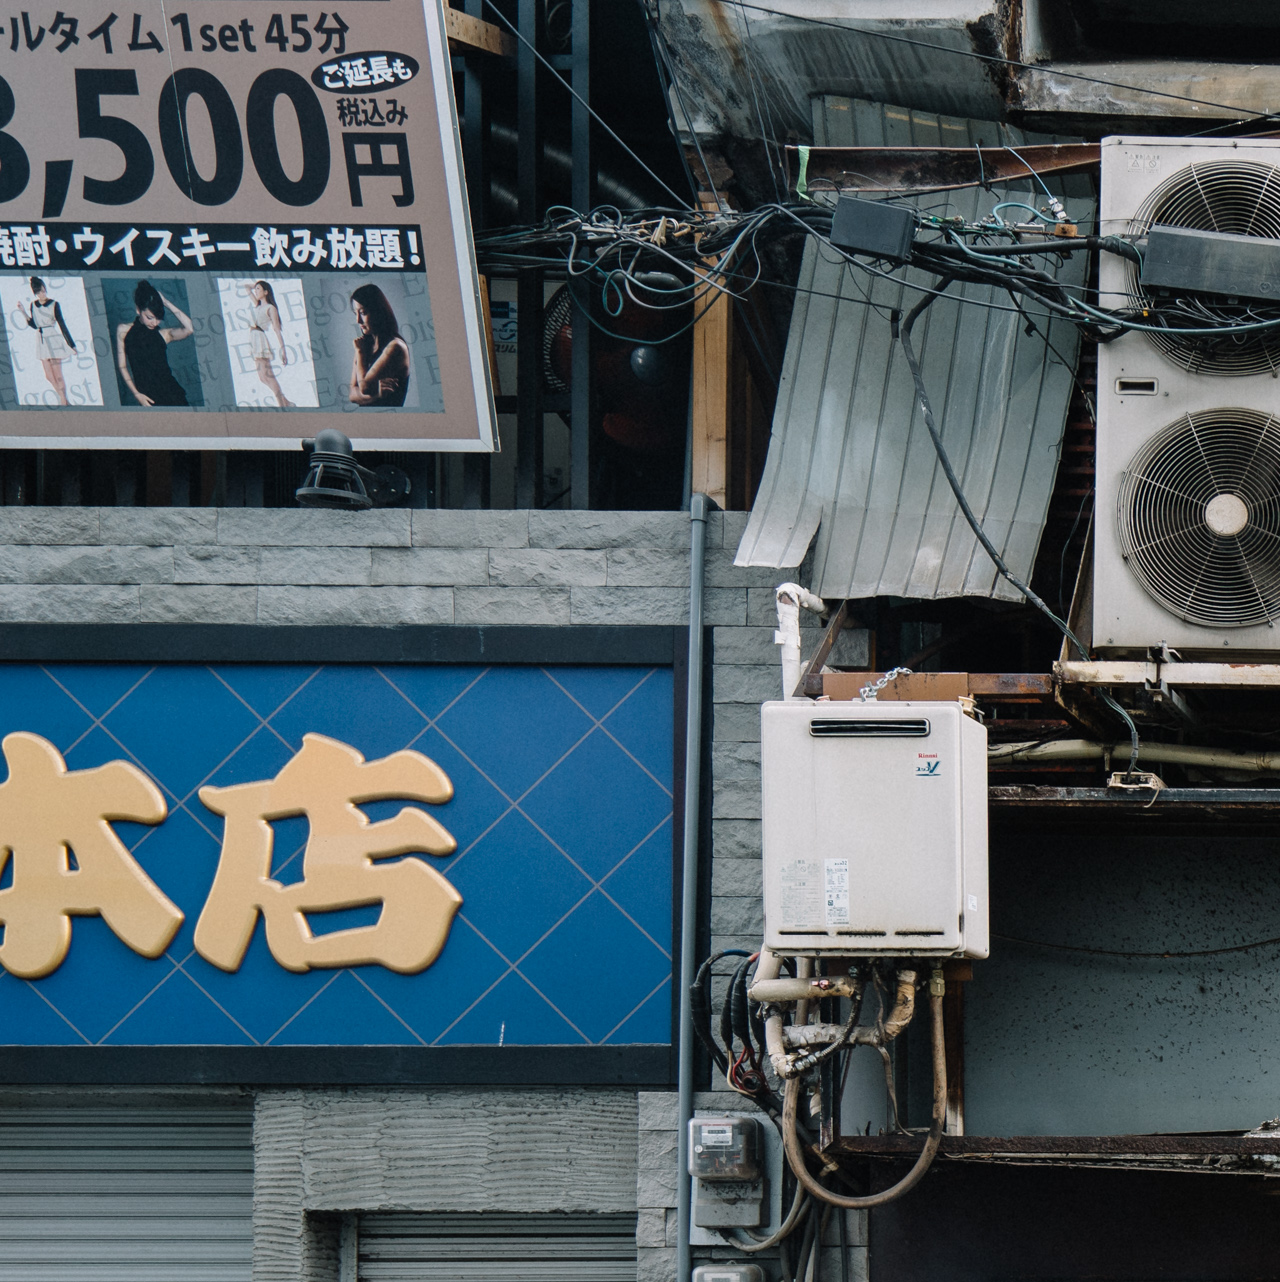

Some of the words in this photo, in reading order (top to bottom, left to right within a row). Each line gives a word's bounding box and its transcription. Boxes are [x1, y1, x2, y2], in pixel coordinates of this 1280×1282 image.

[0, 11, 164, 54] ルタイム
[170, 13, 257, 54] 1set
[264, 12, 350, 54] 45分
[322, 56, 412, 90] ご延長も
[336, 97, 409, 127] 税込み
[341, 132, 416, 208] 円
[0, 730, 463, 979] 本店
